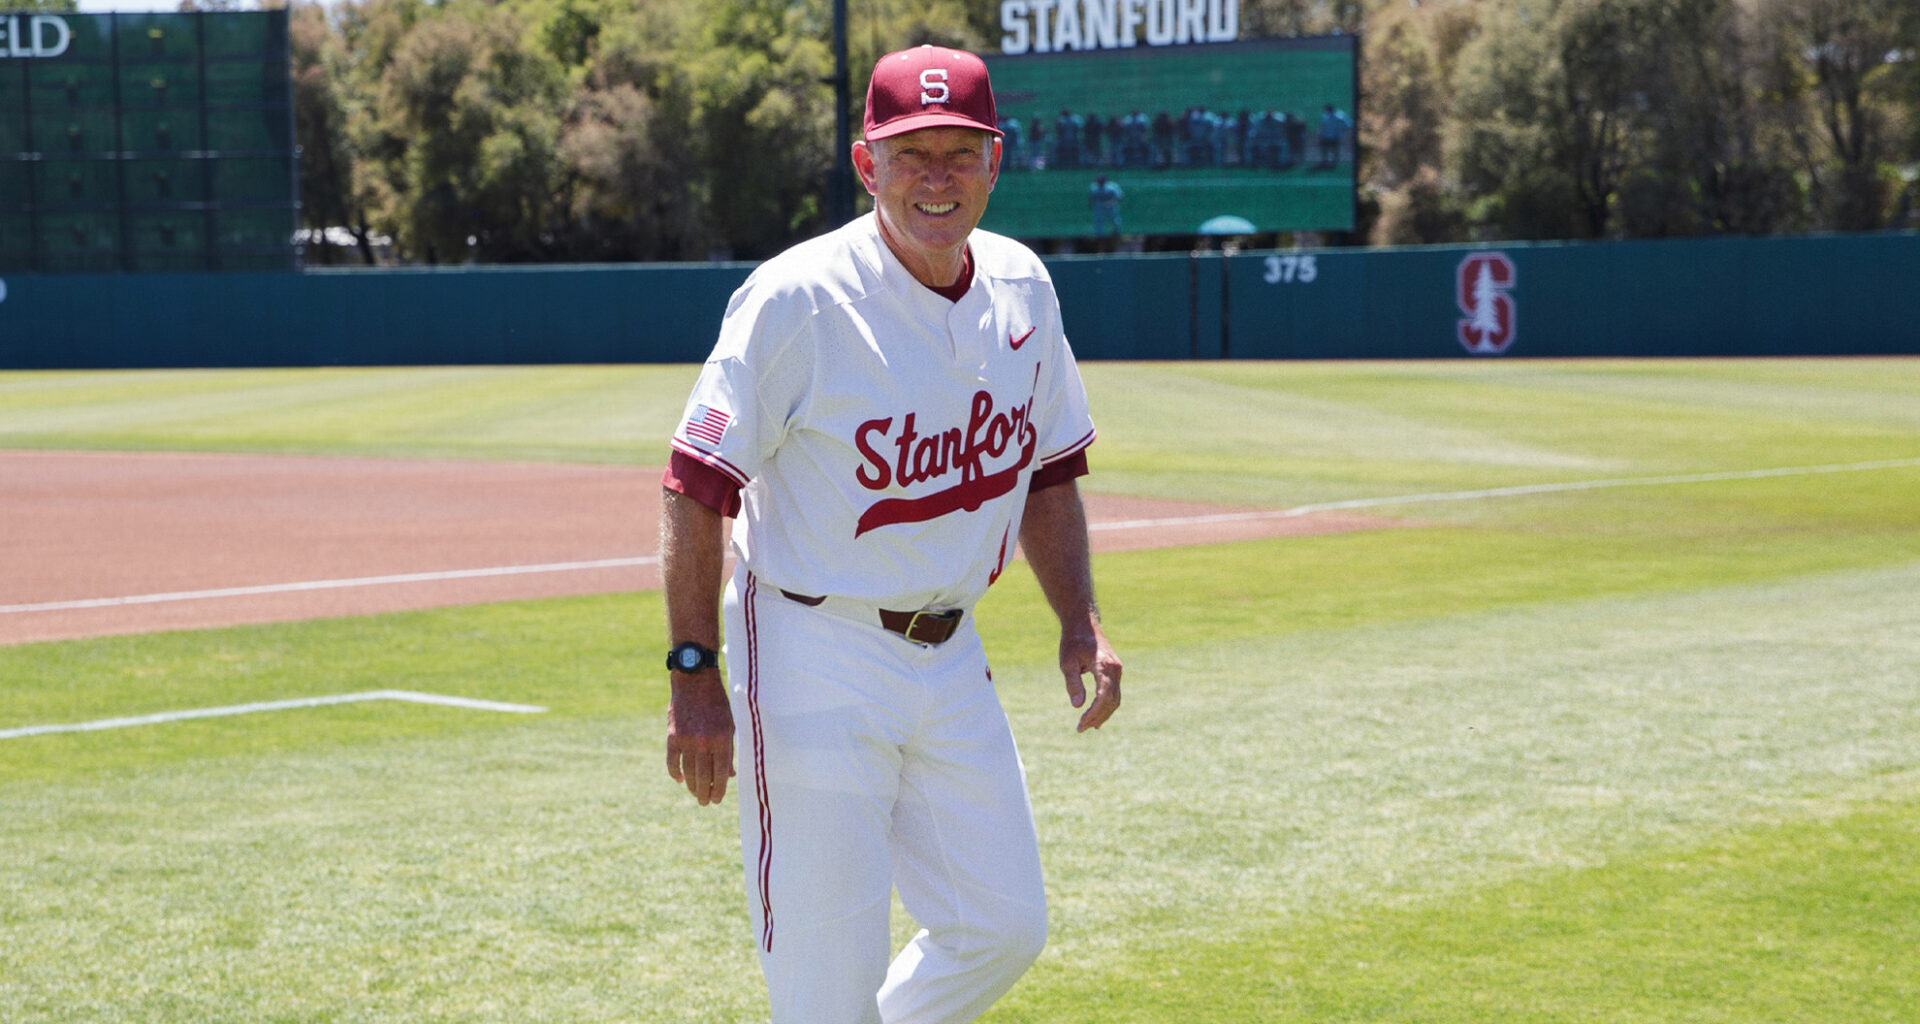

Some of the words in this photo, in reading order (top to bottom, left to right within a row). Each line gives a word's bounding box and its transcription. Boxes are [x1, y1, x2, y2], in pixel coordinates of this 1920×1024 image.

[1000, 0, 1239, 55] STANFORD
[919, 68, 949, 105] S
[1264, 256, 1317, 283] 375
